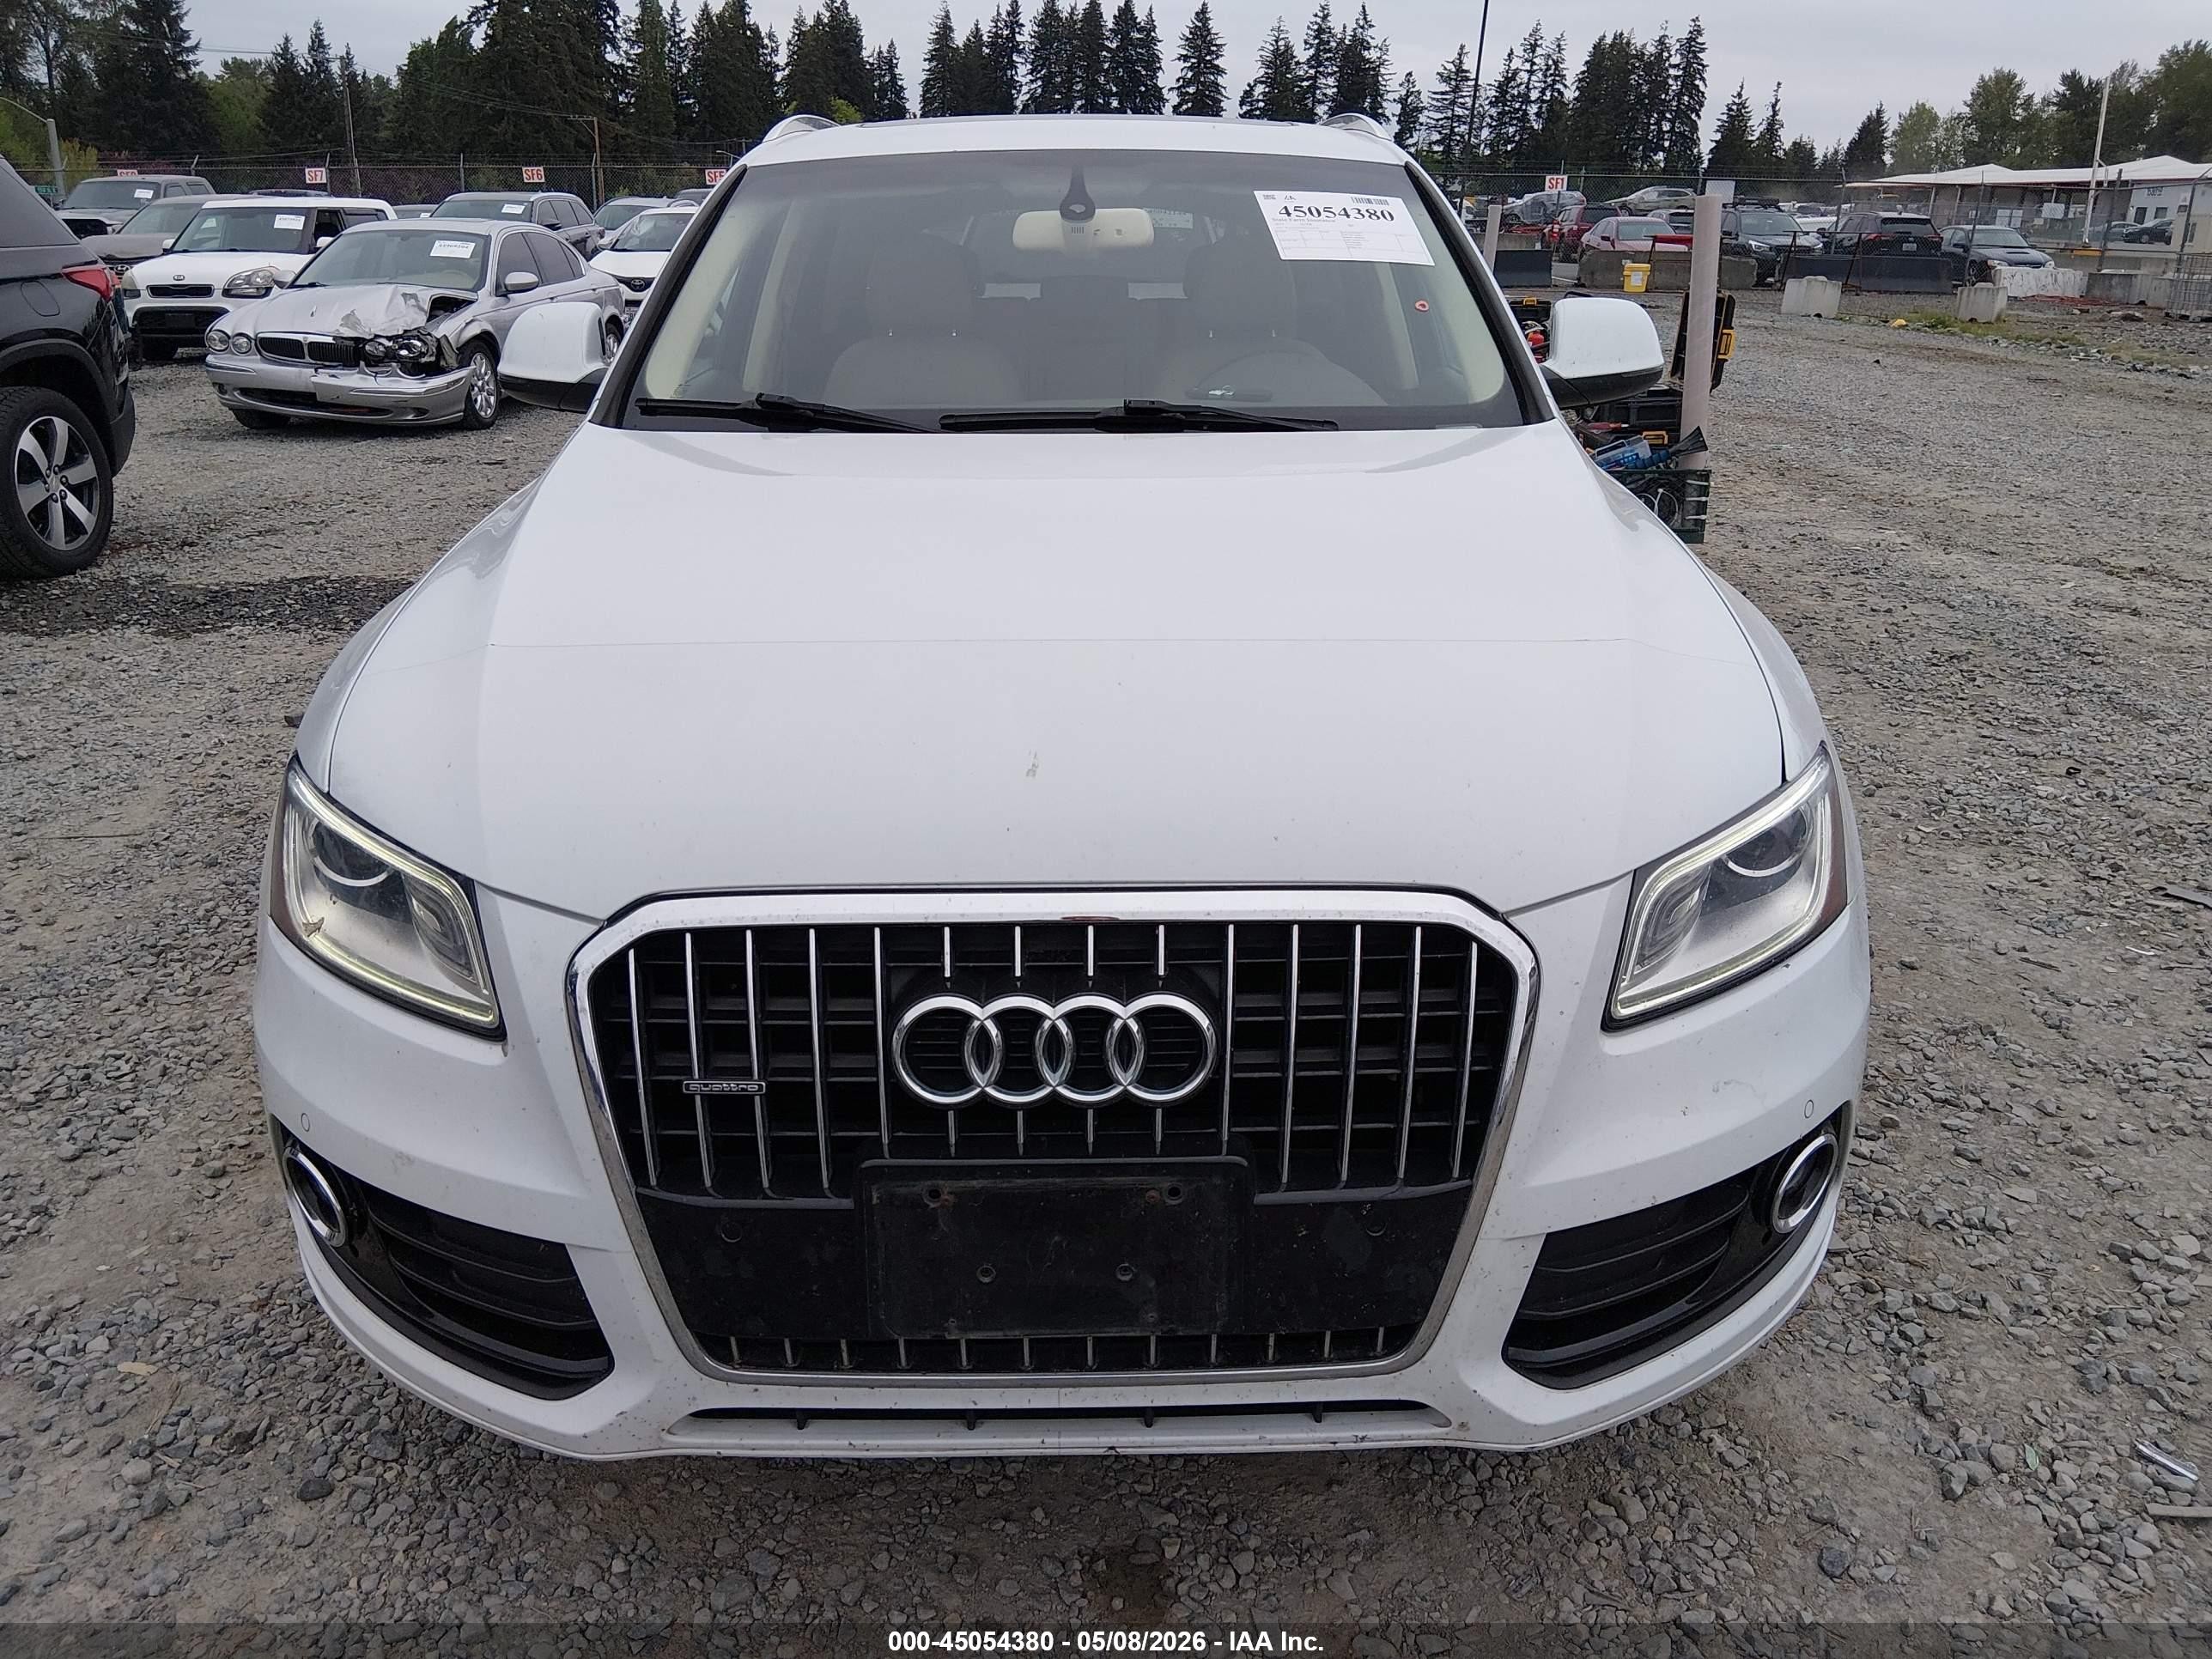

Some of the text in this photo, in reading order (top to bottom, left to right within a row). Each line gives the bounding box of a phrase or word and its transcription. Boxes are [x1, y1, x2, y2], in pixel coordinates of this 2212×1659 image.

[307, 170, 324, 181] SF7
[525, 168, 543, 181] SF6
[1548, 177, 1565, 190] SF1
[1278, 205, 1395, 222] 45054380
[689, 1084, 759, 1093] quattro
